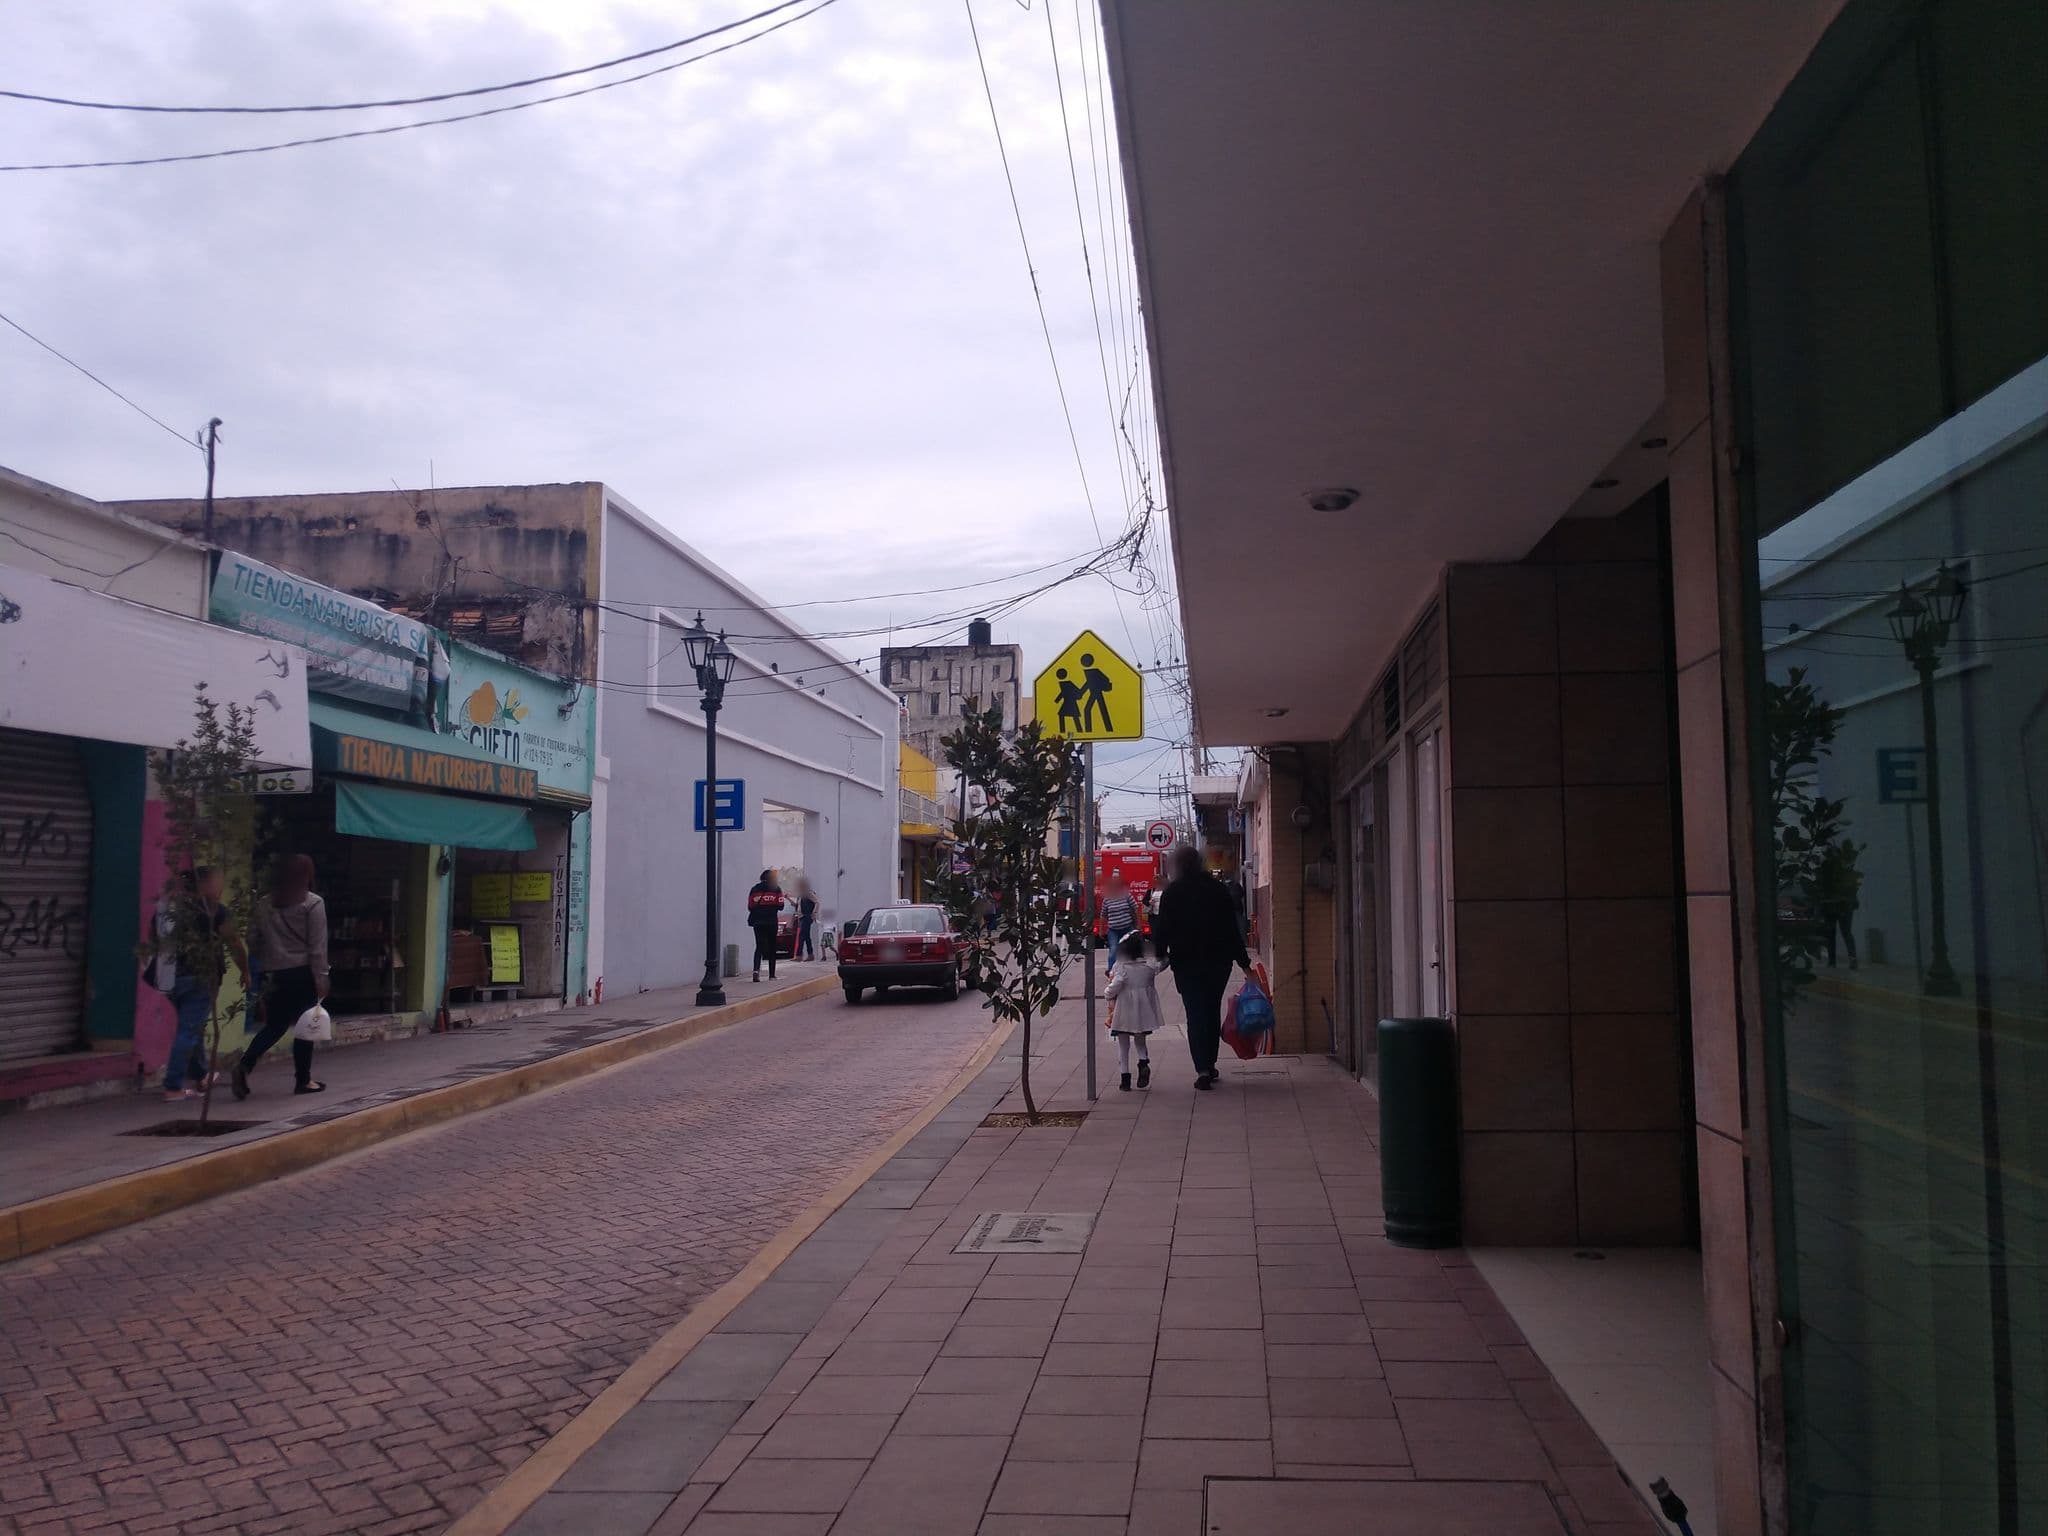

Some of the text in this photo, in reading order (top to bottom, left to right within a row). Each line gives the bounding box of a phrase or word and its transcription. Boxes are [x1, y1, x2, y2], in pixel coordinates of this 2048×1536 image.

[233, 563, 306, 614] TIENDA
[309, 591, 401, 648] NATURISTA
[342, 735, 536, 799] TIENDA NATURISTA SILOE
[703, 783, 735, 827] E
